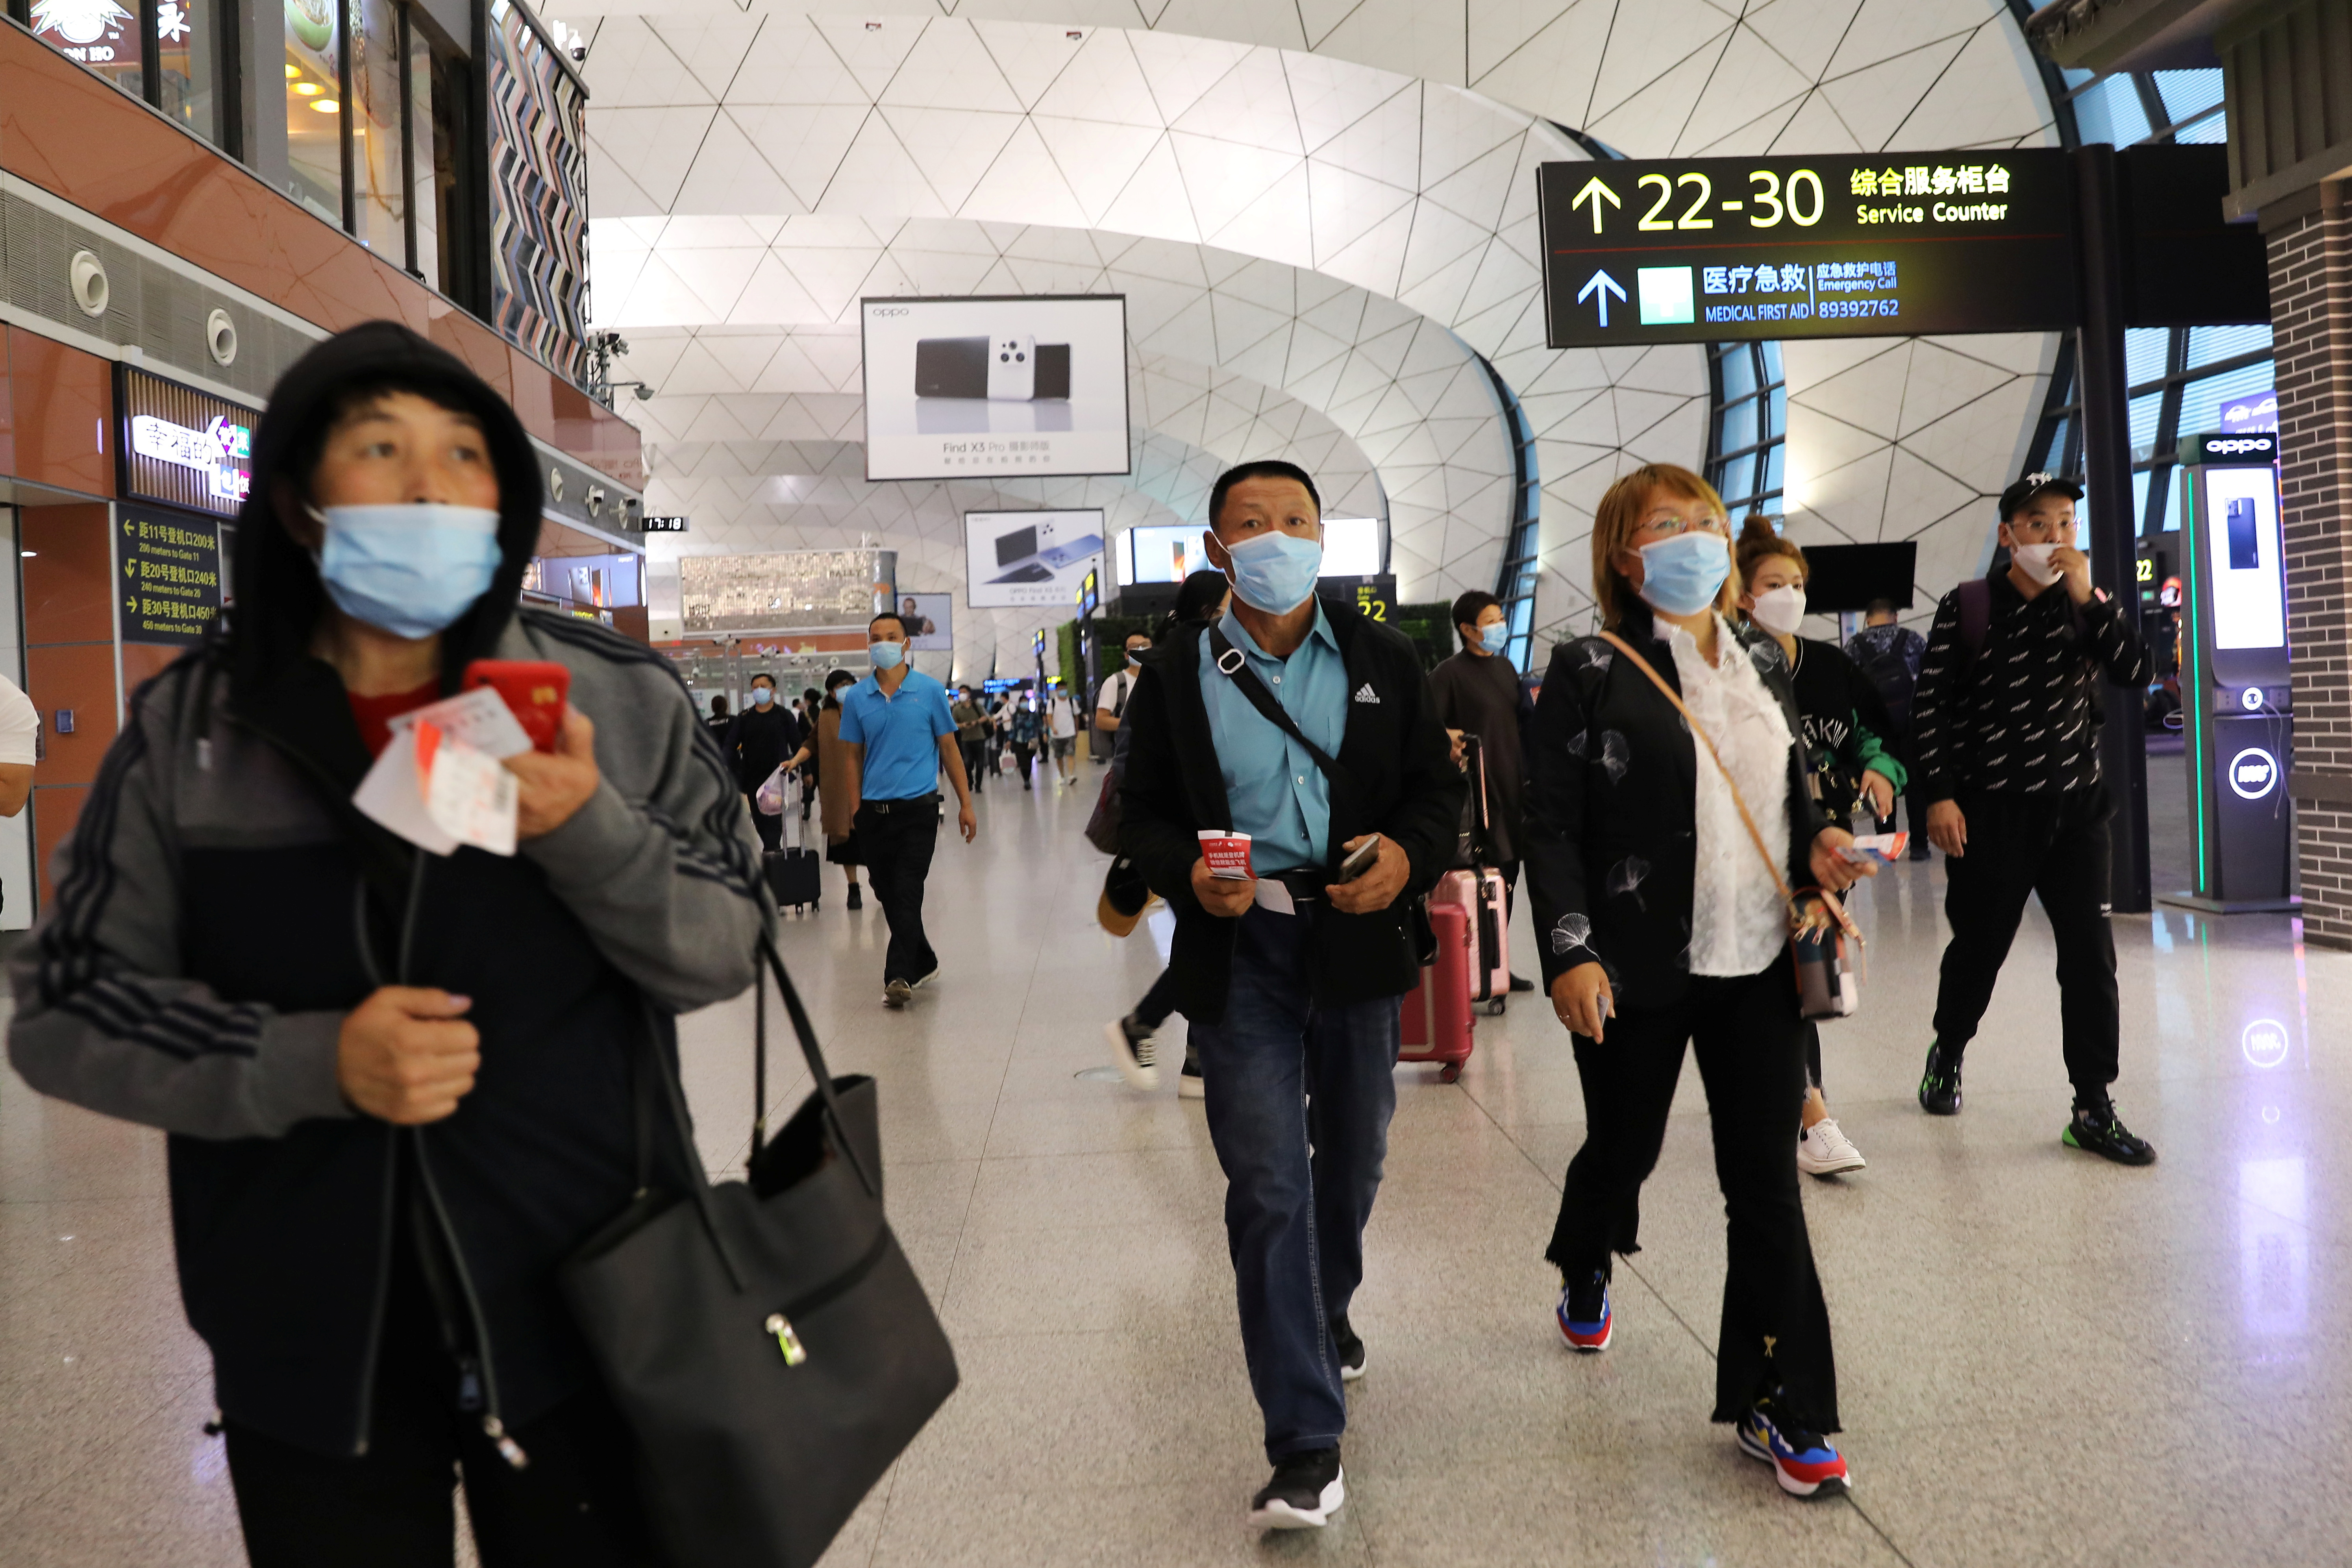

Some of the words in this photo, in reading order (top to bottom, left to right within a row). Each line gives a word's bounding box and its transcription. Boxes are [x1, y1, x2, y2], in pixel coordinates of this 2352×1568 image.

[89, 46, 115, 61] HO
[1850, 163, 2010, 197] 综合服务柜台
[1638, 169, 1824, 231] 22-30
[1857, 203, 1924, 224] Service
[1932, 202, 2008, 222] Counter
[1703, 263, 1806, 294] 医疗急救
[1817, 261, 1896, 279] 应急救护电话
[1818, 279, 1876, 293] Emergency
[1877, 277, 1897, 289] Call
[1705, 305, 1756, 322] MEDICAL
[1758, 303, 1788, 320] FIRST
[1789, 303, 1810, 320] AID
[1819, 299, 1899, 319] 89392762
[146, 422, 213, 465] 幸福的
[944, 442, 966, 453] Find
[971, 442, 985, 453] X3
[989, 442, 1005, 451] Pro
[649, 518, 681, 530] 17:18
[139, 521, 215, 551] 距11号登机口200米
[193, 552, 199, 562] 11
[141, 560, 217, 588] 距20号登机口240米
[2136, 559, 2153, 581] 22
[141, 581, 153, 592] 240
[1358, 600, 1386, 622] 22
[1355, 695, 1380, 704] adidas
